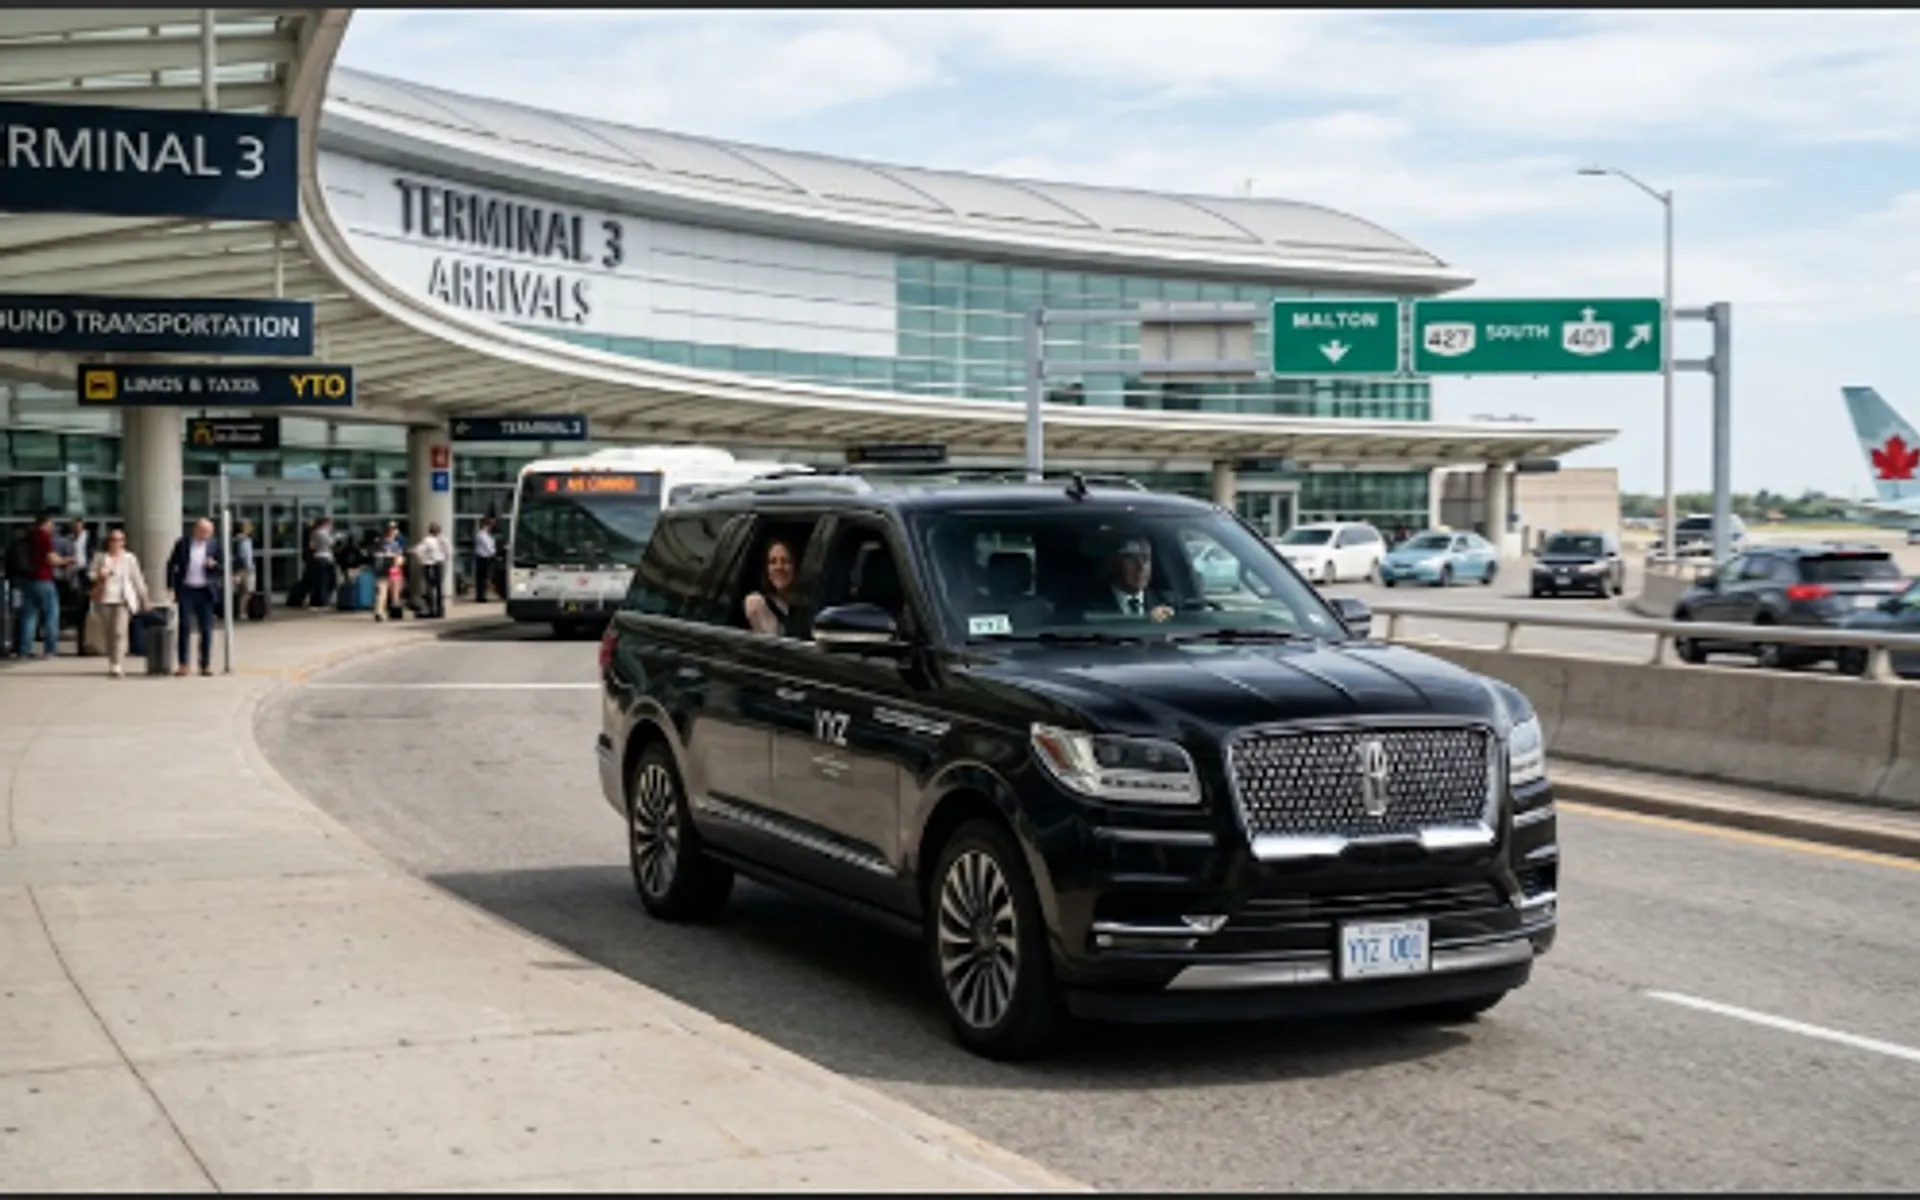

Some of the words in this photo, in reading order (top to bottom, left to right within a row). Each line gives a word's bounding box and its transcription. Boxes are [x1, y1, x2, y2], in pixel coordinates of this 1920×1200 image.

[0, 123, 222, 176] RMINAL
[235, 135, 266, 178] 3
[393, 178, 593, 264] TERMINAL
[602, 220, 624, 268] 3
[429, 257, 590, 325] ARRIVALS
[0, 308, 67, 334] UND
[73, 309, 300, 338] TRANSPORTATION
[1293, 311, 1379, 329] MALTON
[1428, 327, 1471, 349] 427
[1485, 323, 1550, 341] SOUTH
[1567, 328, 1607, 348] 401
[123, 375, 183, 393] LIMOS
[207, 376, 260, 393] TAXIS
[289, 373, 347, 398] YTO
[814, 708, 851, 746] YYZ
[1348, 937, 1381, 963] YYZ
